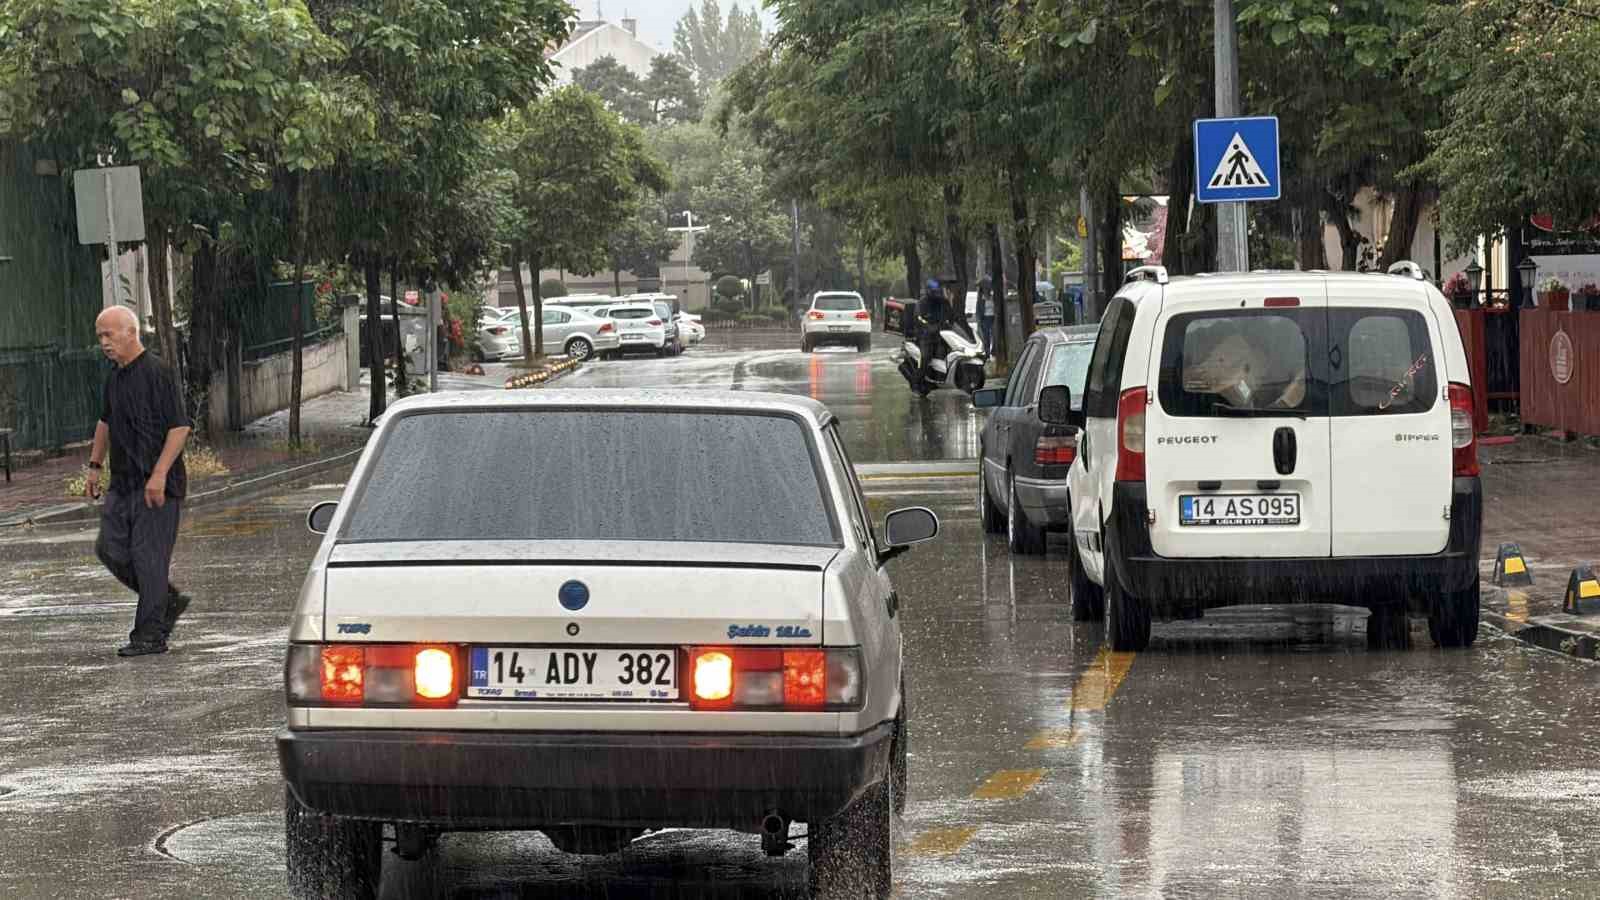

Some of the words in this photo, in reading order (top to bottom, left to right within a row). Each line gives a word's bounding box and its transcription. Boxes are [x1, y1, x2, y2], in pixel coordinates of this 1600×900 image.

[1157, 436, 1219, 446] PEUGEOT
[1395, 433, 1440, 442] BIPPER
[1193, 498, 1216, 517] 14
[1224, 498, 1255, 517] AS
[1258, 498, 1295, 516] 095
[494, 651, 526, 684] 14
[545, 652, 598, 685] ADY
[617, 653, 671, 685] 382
[473, 670, 488, 680] TR
